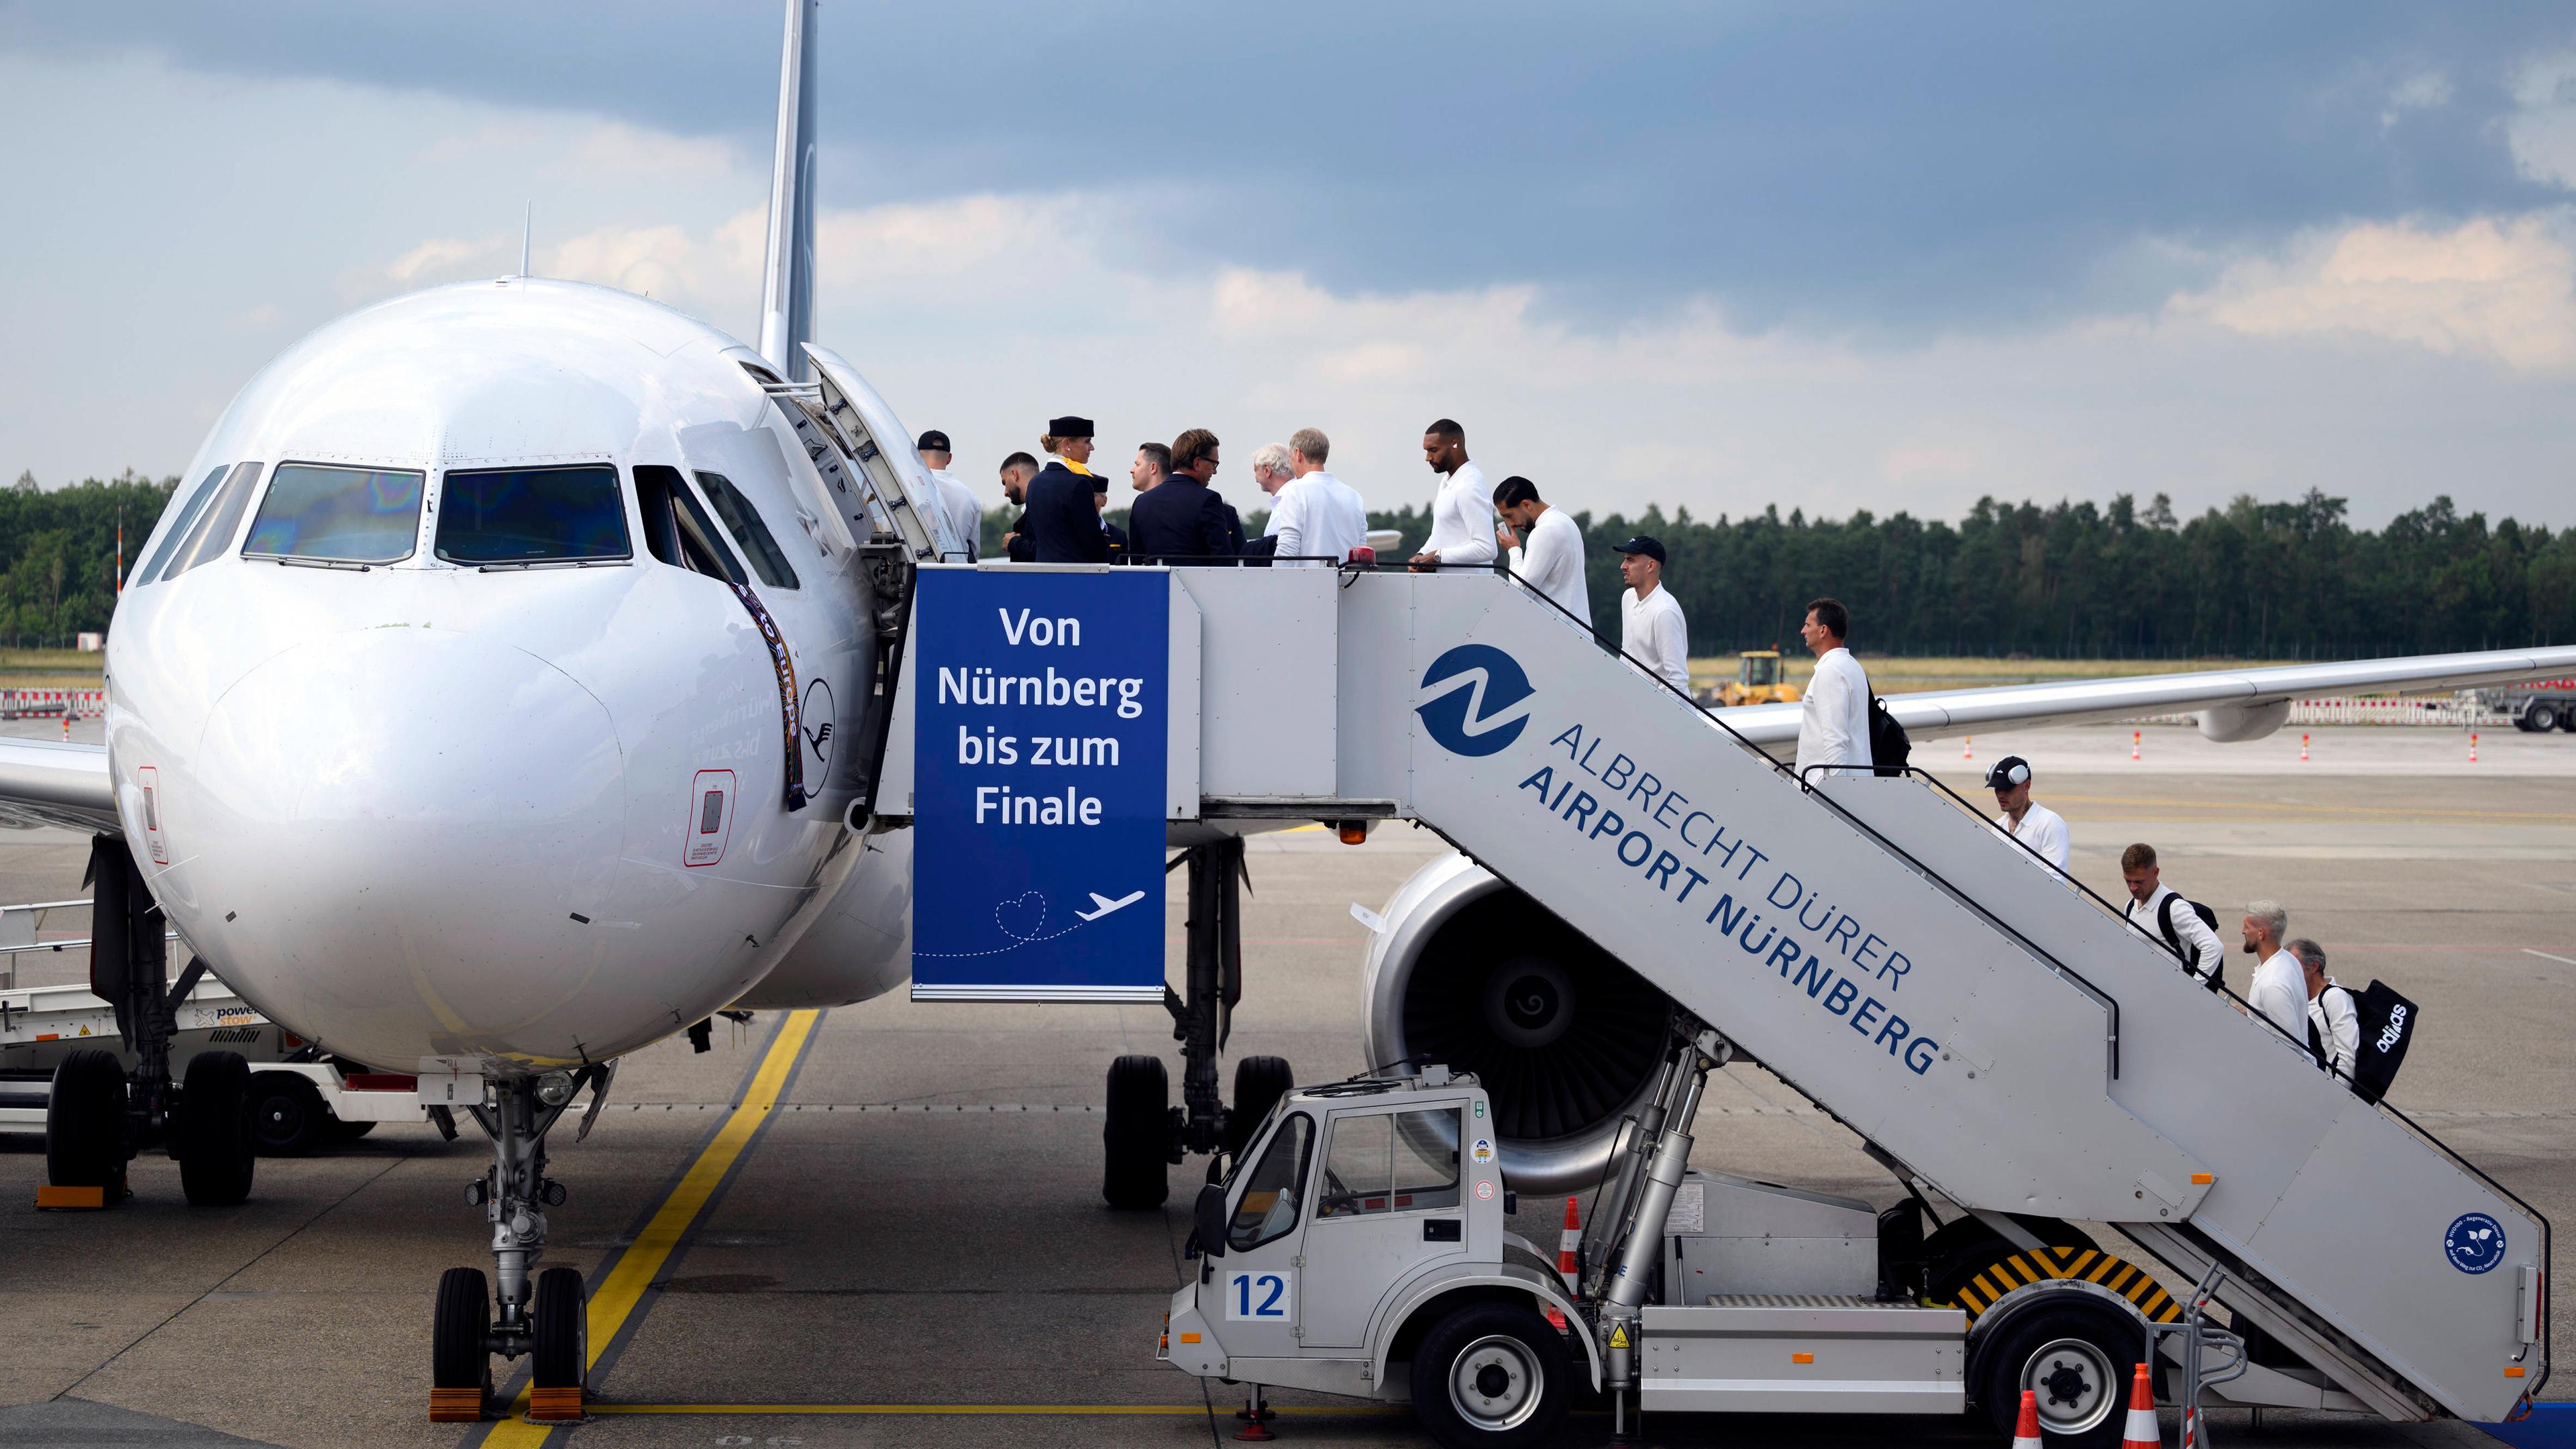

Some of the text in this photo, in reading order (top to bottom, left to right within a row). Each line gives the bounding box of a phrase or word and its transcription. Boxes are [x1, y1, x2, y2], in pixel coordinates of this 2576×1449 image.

[999, 608, 1080, 646] Von
[760, 612, 775, 638] to
[775, 641, 797, 737] Europe
[938, 666, 1143, 718] Nürnberg
[959, 725, 1119, 765] bis zum
[976, 786, 1102, 826] Finale
[1550, 724, 1911, 991] ALBRECHT DÜRER
[1519, 766, 1938, 1075] AIRPORT NÜRNBERG
[220, 1016, 252, 1026] stow
[2449, 1221, 2463, 1237] HVO100
[2467, 1216, 2493, 1226] Regenerativ
[2491, 1224, 2502, 1238] Diesel
[1234, 1275, 1283, 1316] 12
